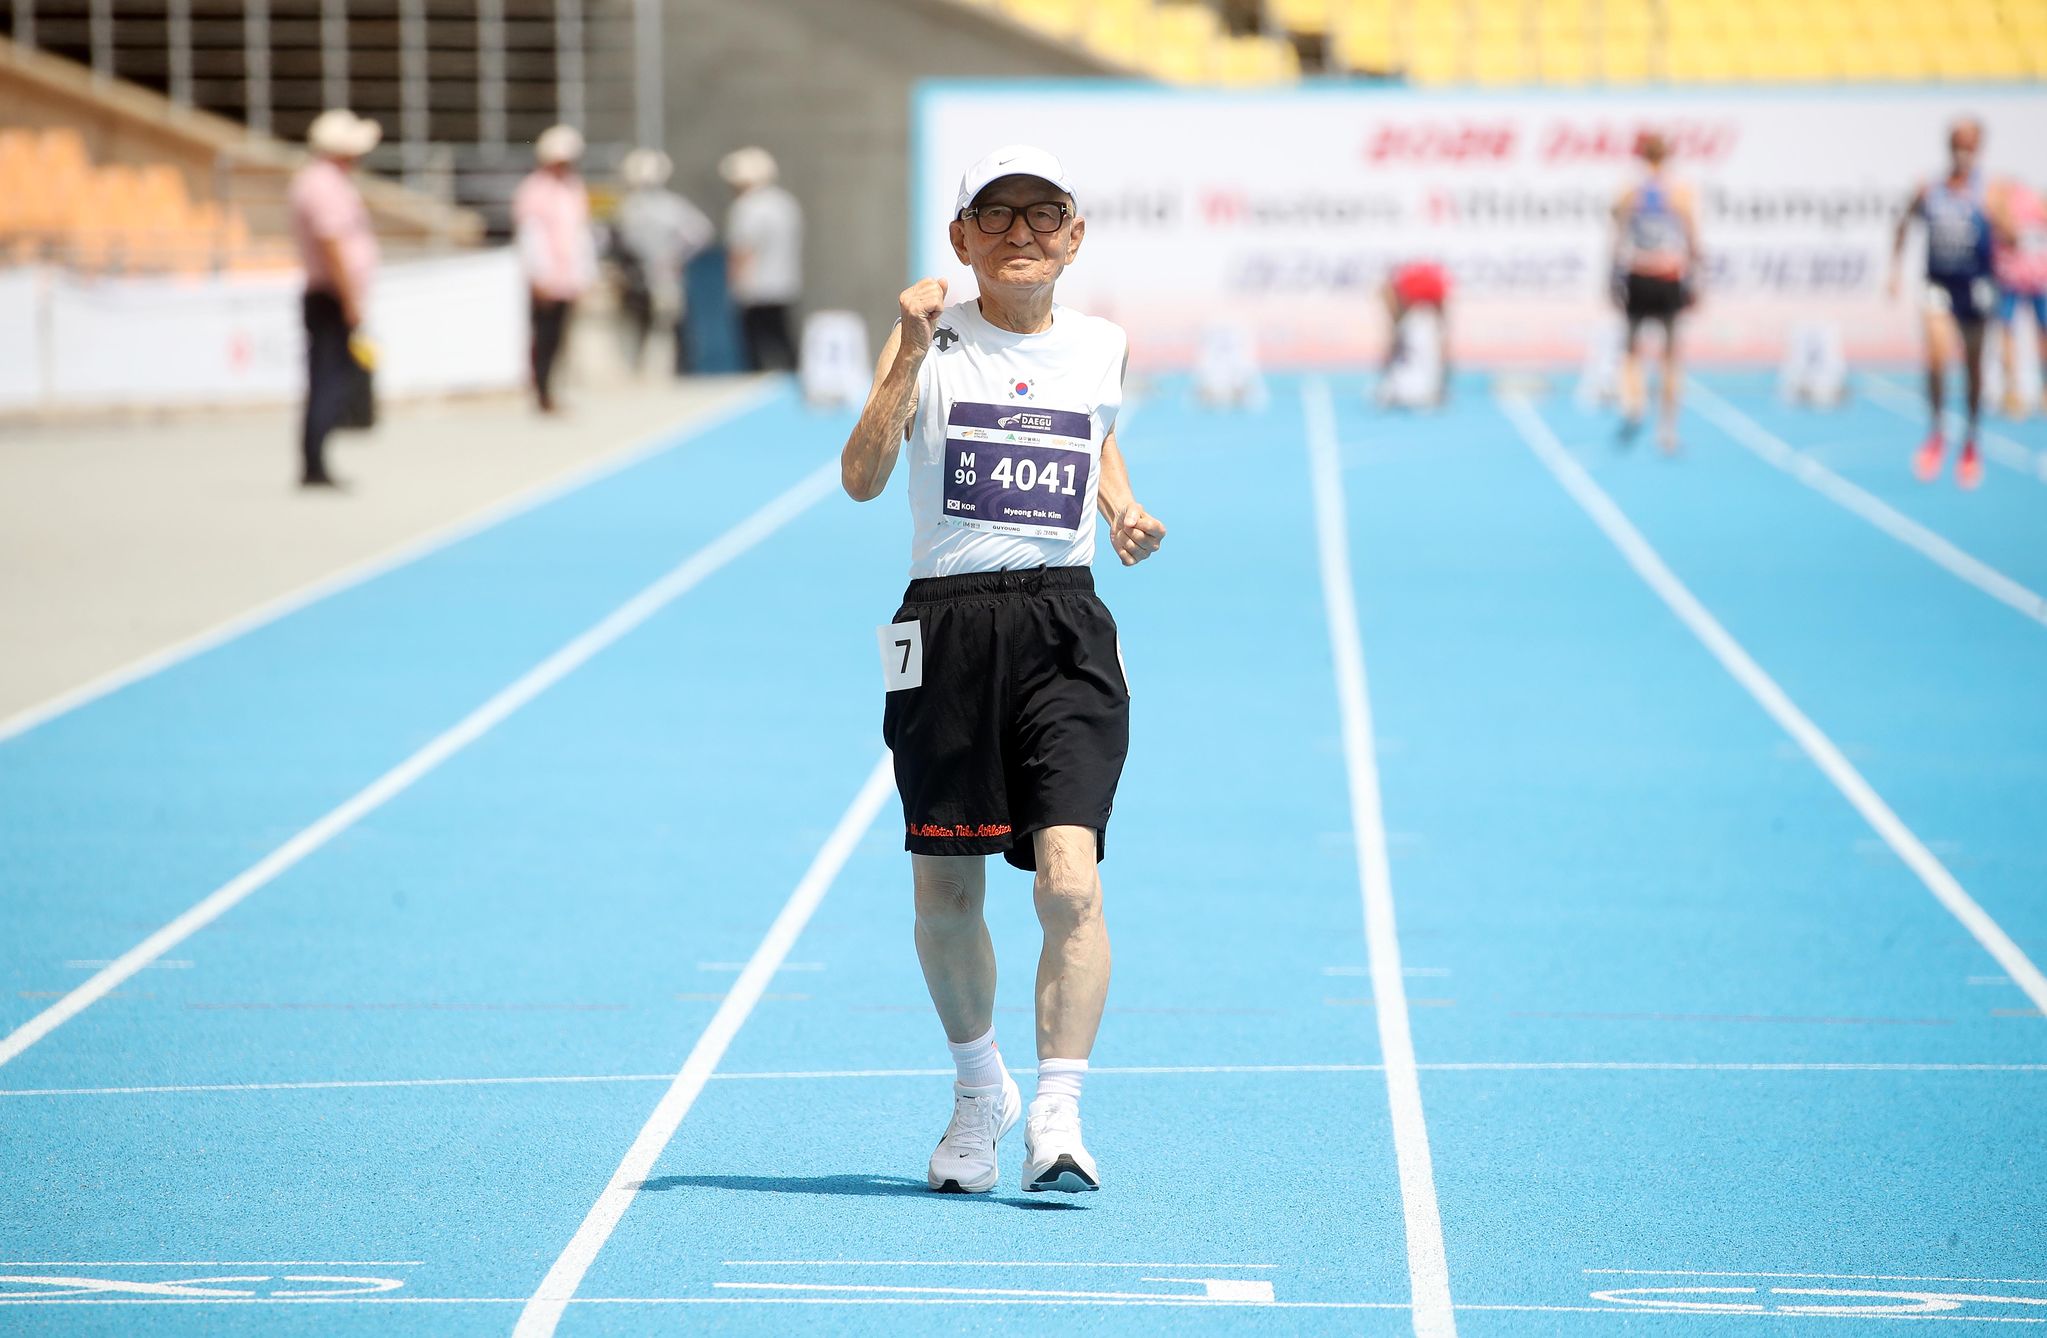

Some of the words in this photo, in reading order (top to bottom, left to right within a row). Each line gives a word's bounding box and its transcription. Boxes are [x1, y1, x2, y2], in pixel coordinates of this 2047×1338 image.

[1022, 416, 1052, 427] DAEGU
[960, 452, 976, 468] M
[955, 469, 977, 486] 90
[990, 457, 1077, 496] 4041
[961, 502, 976, 511] KOR
[1004, 507, 1032, 518] Myeong
[1033, 509, 1047, 518] Rak
[1048, 511, 1062, 519] Kim
[894, 638, 913, 674] 7
[919, 823, 954, 837] Athletics
[974, 823, 1012, 837] Athletics
